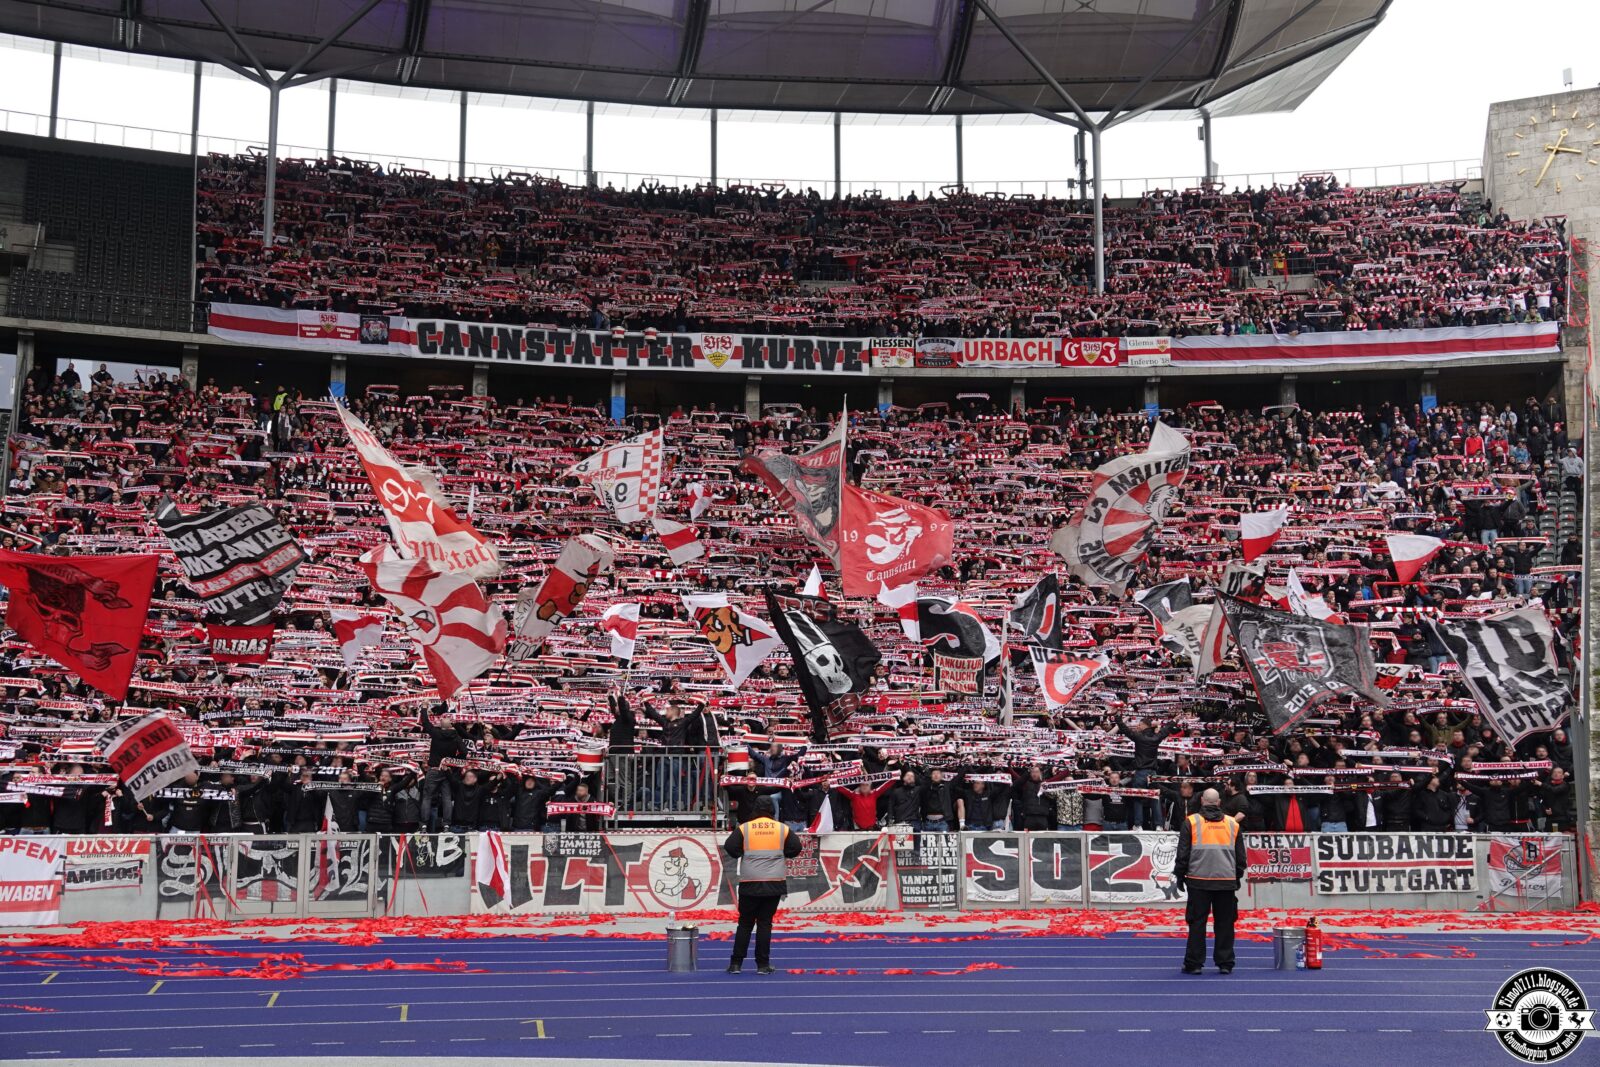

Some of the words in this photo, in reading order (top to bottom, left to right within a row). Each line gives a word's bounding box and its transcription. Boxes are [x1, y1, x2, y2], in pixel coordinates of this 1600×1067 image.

[417, 322, 695, 368] CANNSTATTER
[703, 334, 733, 350] VfB
[873, 340, 913, 348] HESSEN
[742, 337, 863, 372] KURVE
[964, 340, 1052, 362] URBACH
[930, 523, 949, 532] 97
[843, 530, 859, 543] 19
[866, 559, 917, 582] Cannstatt
[212, 638, 268, 652] ULTRAS
[935, 655, 983, 670] FANKULTUR
[941, 668, 976, 682] BRAUCHT
[1284, 684, 1319, 714] 2013
[836, 772, 893, 784] COMMANDO
[560, 840, 602, 849] IMMER
[1248, 834, 1306, 849] CREW
[1317, 833, 1473, 861] SÜDBANDE
[578, 848, 602, 856] UNS!
[1268, 849, 1292, 865] 36
[1250, 864, 1309, 874] STUTTGART
[901, 875, 934, 885] KAMPF
[936, 873, 956, 884] UND
[1319, 868, 1473, 893] STUTTGART
[902, 886, 938, 895] EINSATZ
[902, 895, 927, 903] UNSERE
